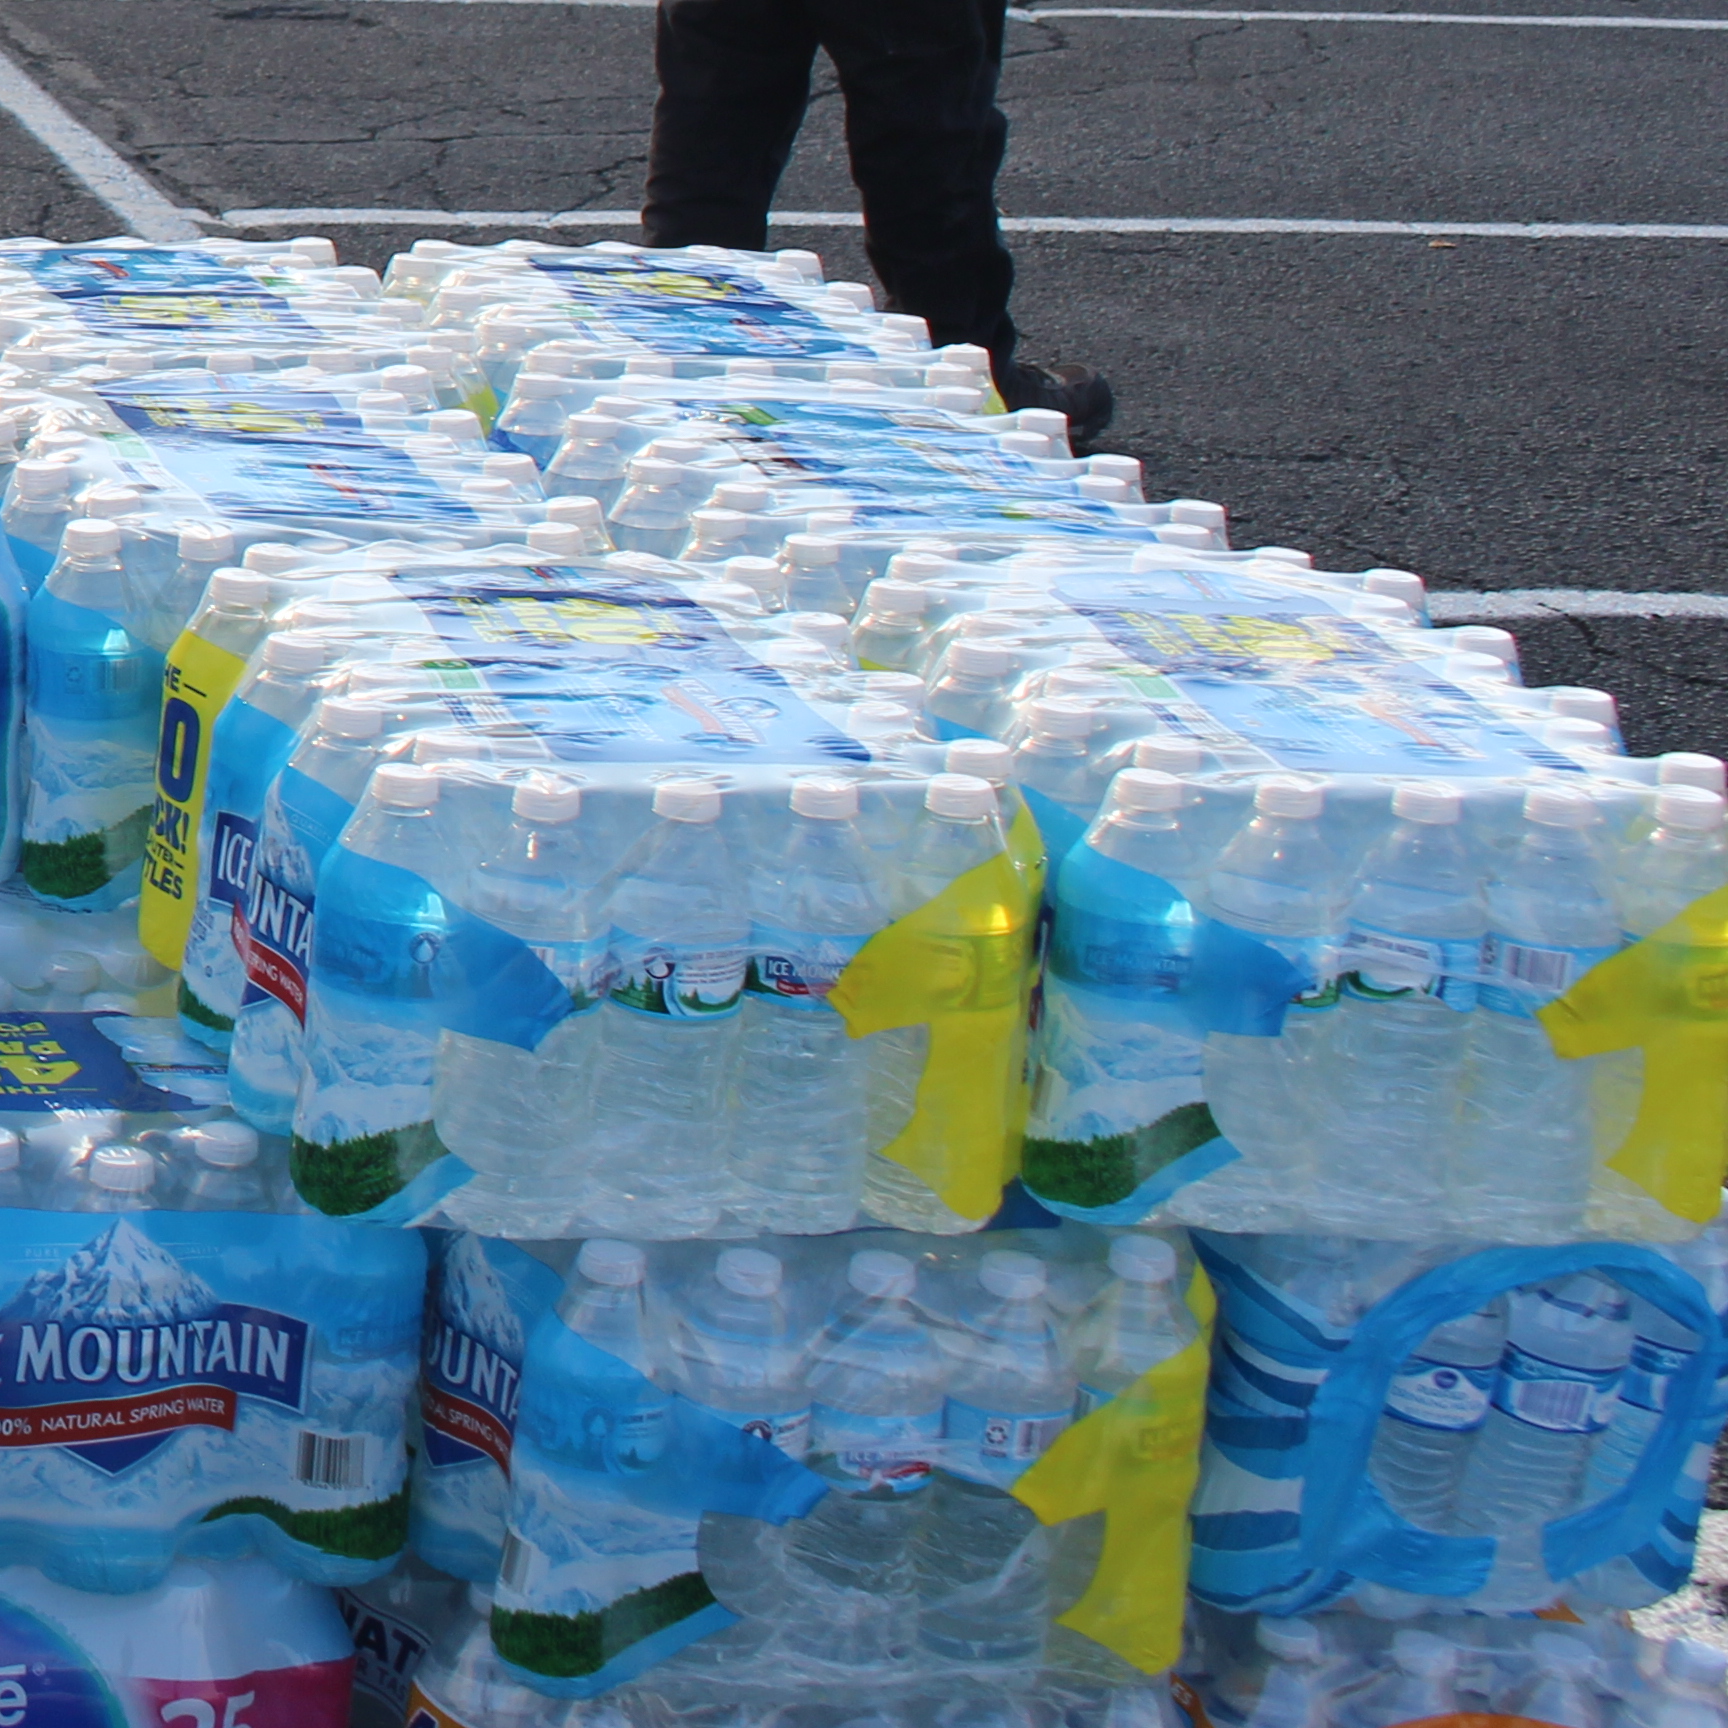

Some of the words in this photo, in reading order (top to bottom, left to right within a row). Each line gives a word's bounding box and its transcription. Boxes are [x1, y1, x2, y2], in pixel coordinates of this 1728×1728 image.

[216, 827, 248, 890] ICE
[25, 1246, 60, 1258] PURE
[15, 1321, 292, 1384] MOUNTAIN
[39, 1409, 126, 1435] NATURAL
[128, 1400, 184, 1428] SPRING
[185, 1395, 226, 1418] WATER
